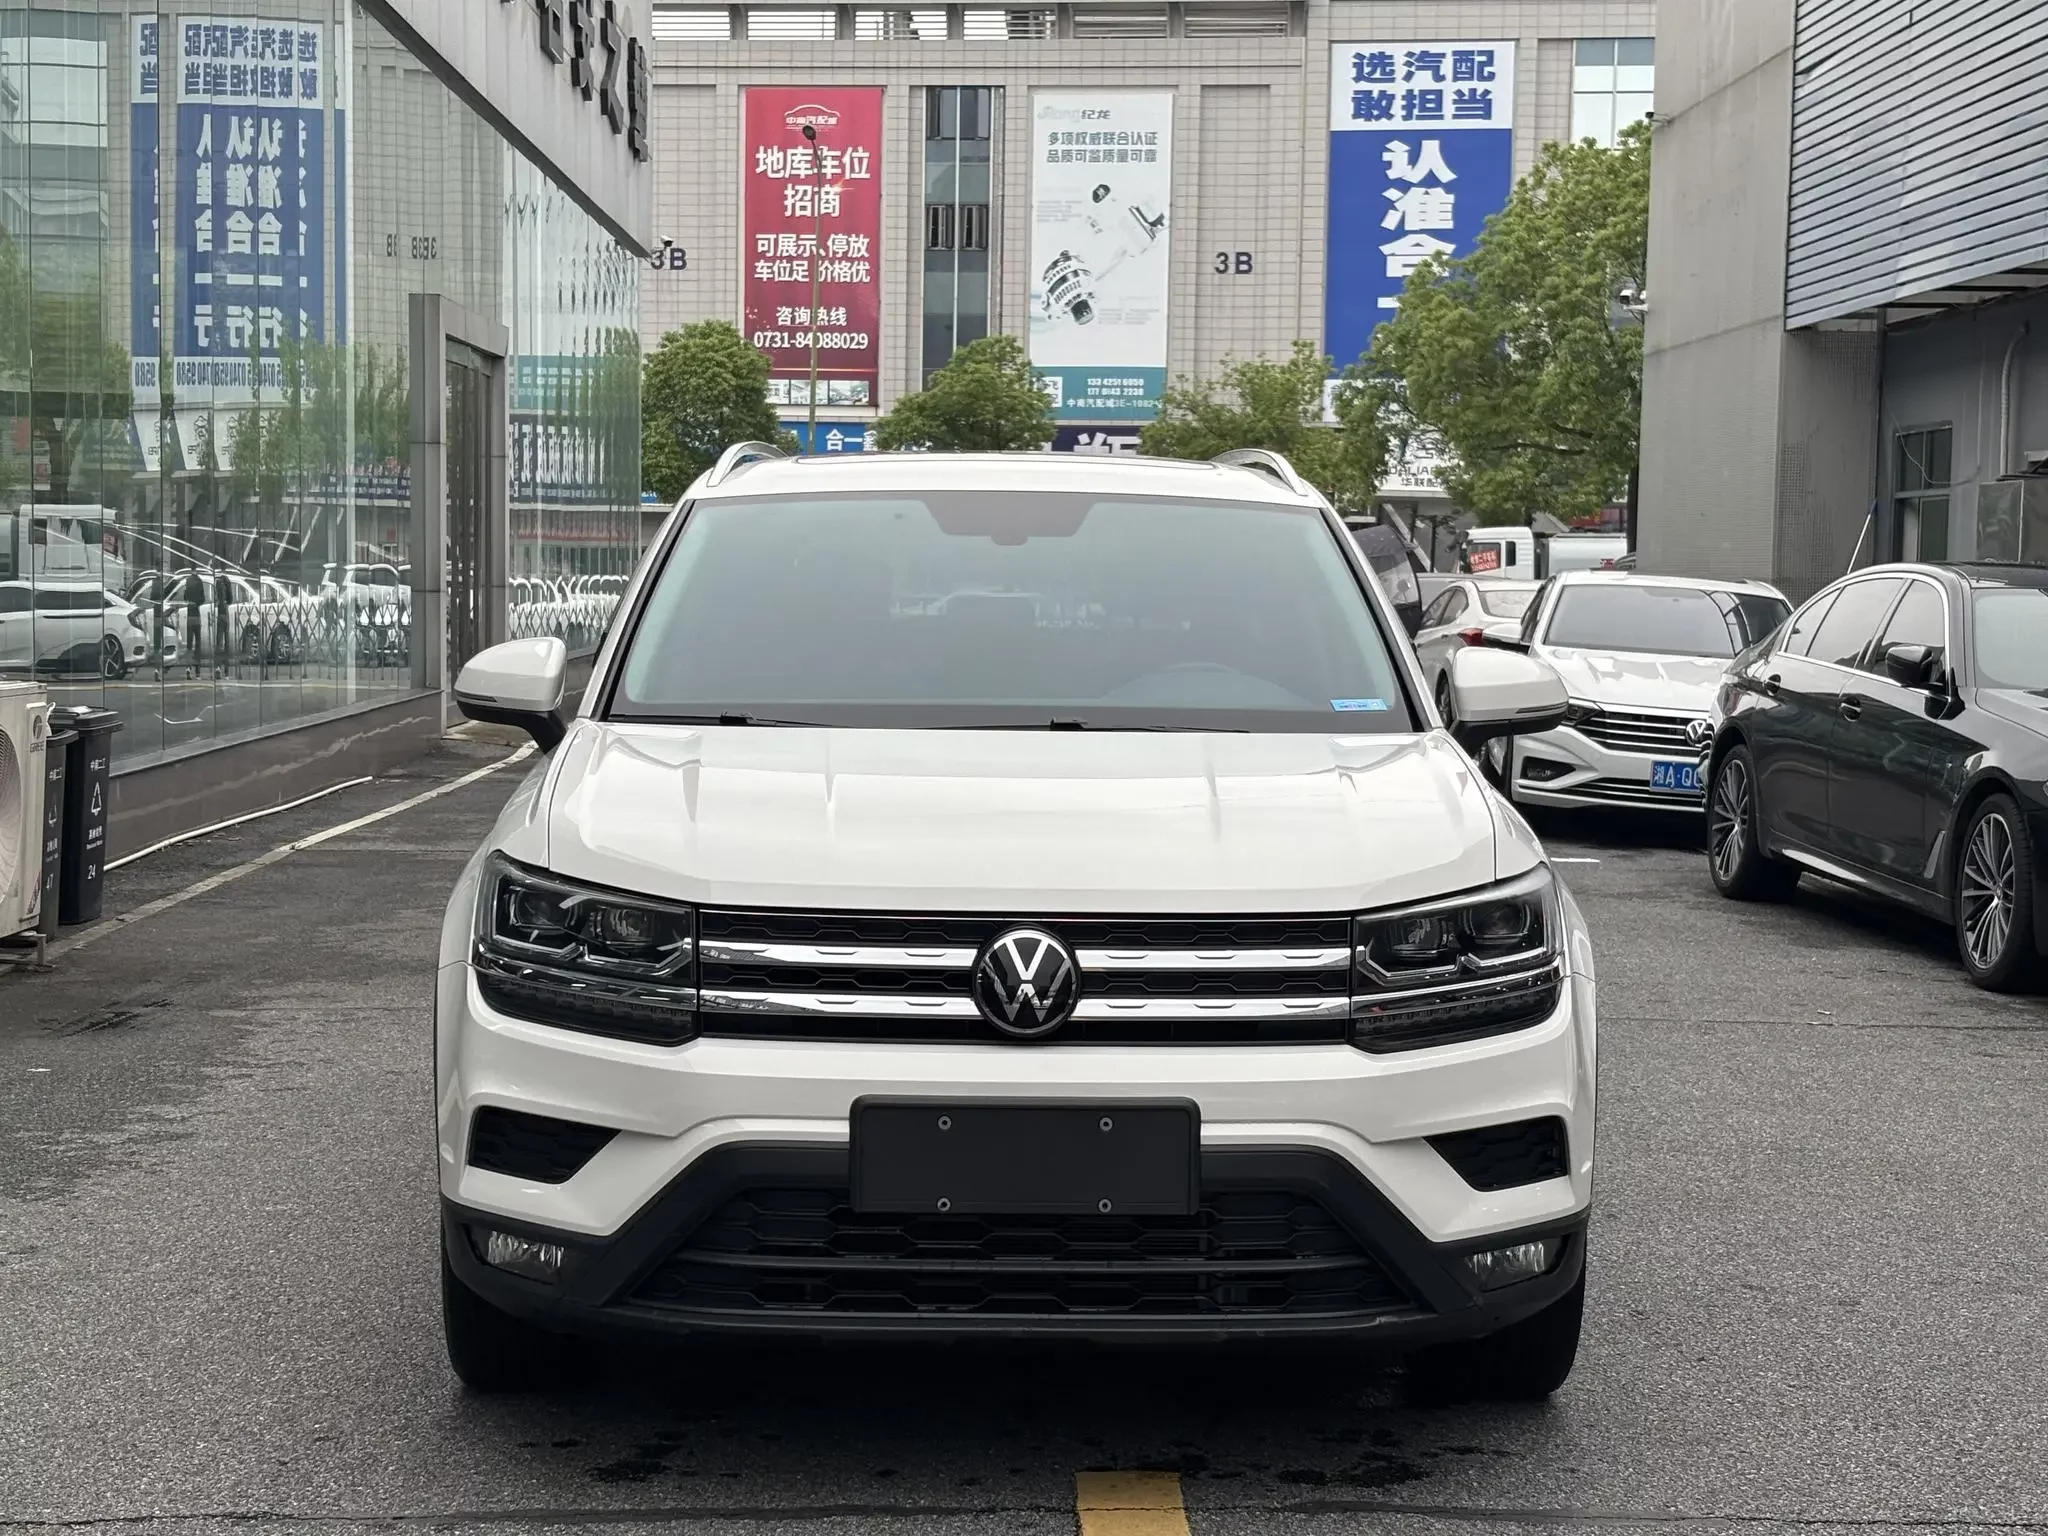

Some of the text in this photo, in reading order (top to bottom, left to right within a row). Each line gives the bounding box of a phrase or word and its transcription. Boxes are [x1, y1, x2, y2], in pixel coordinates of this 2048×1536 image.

[1351, 50, 1496, 84] 选汽配
[1081, 109, 1111, 120] 纪龙
[1351, 88, 1493, 122] 敢担当
[1048, 131, 1157, 146] 多项权威联合认证
[755, 145, 871, 180] 地库车位
[784, 183, 841, 217] 招商
[1214, 251, 1253, 274] 3B
[775, 306, 847, 327] 咨询热线
[754, 331, 869, 350] 0731-84088029
